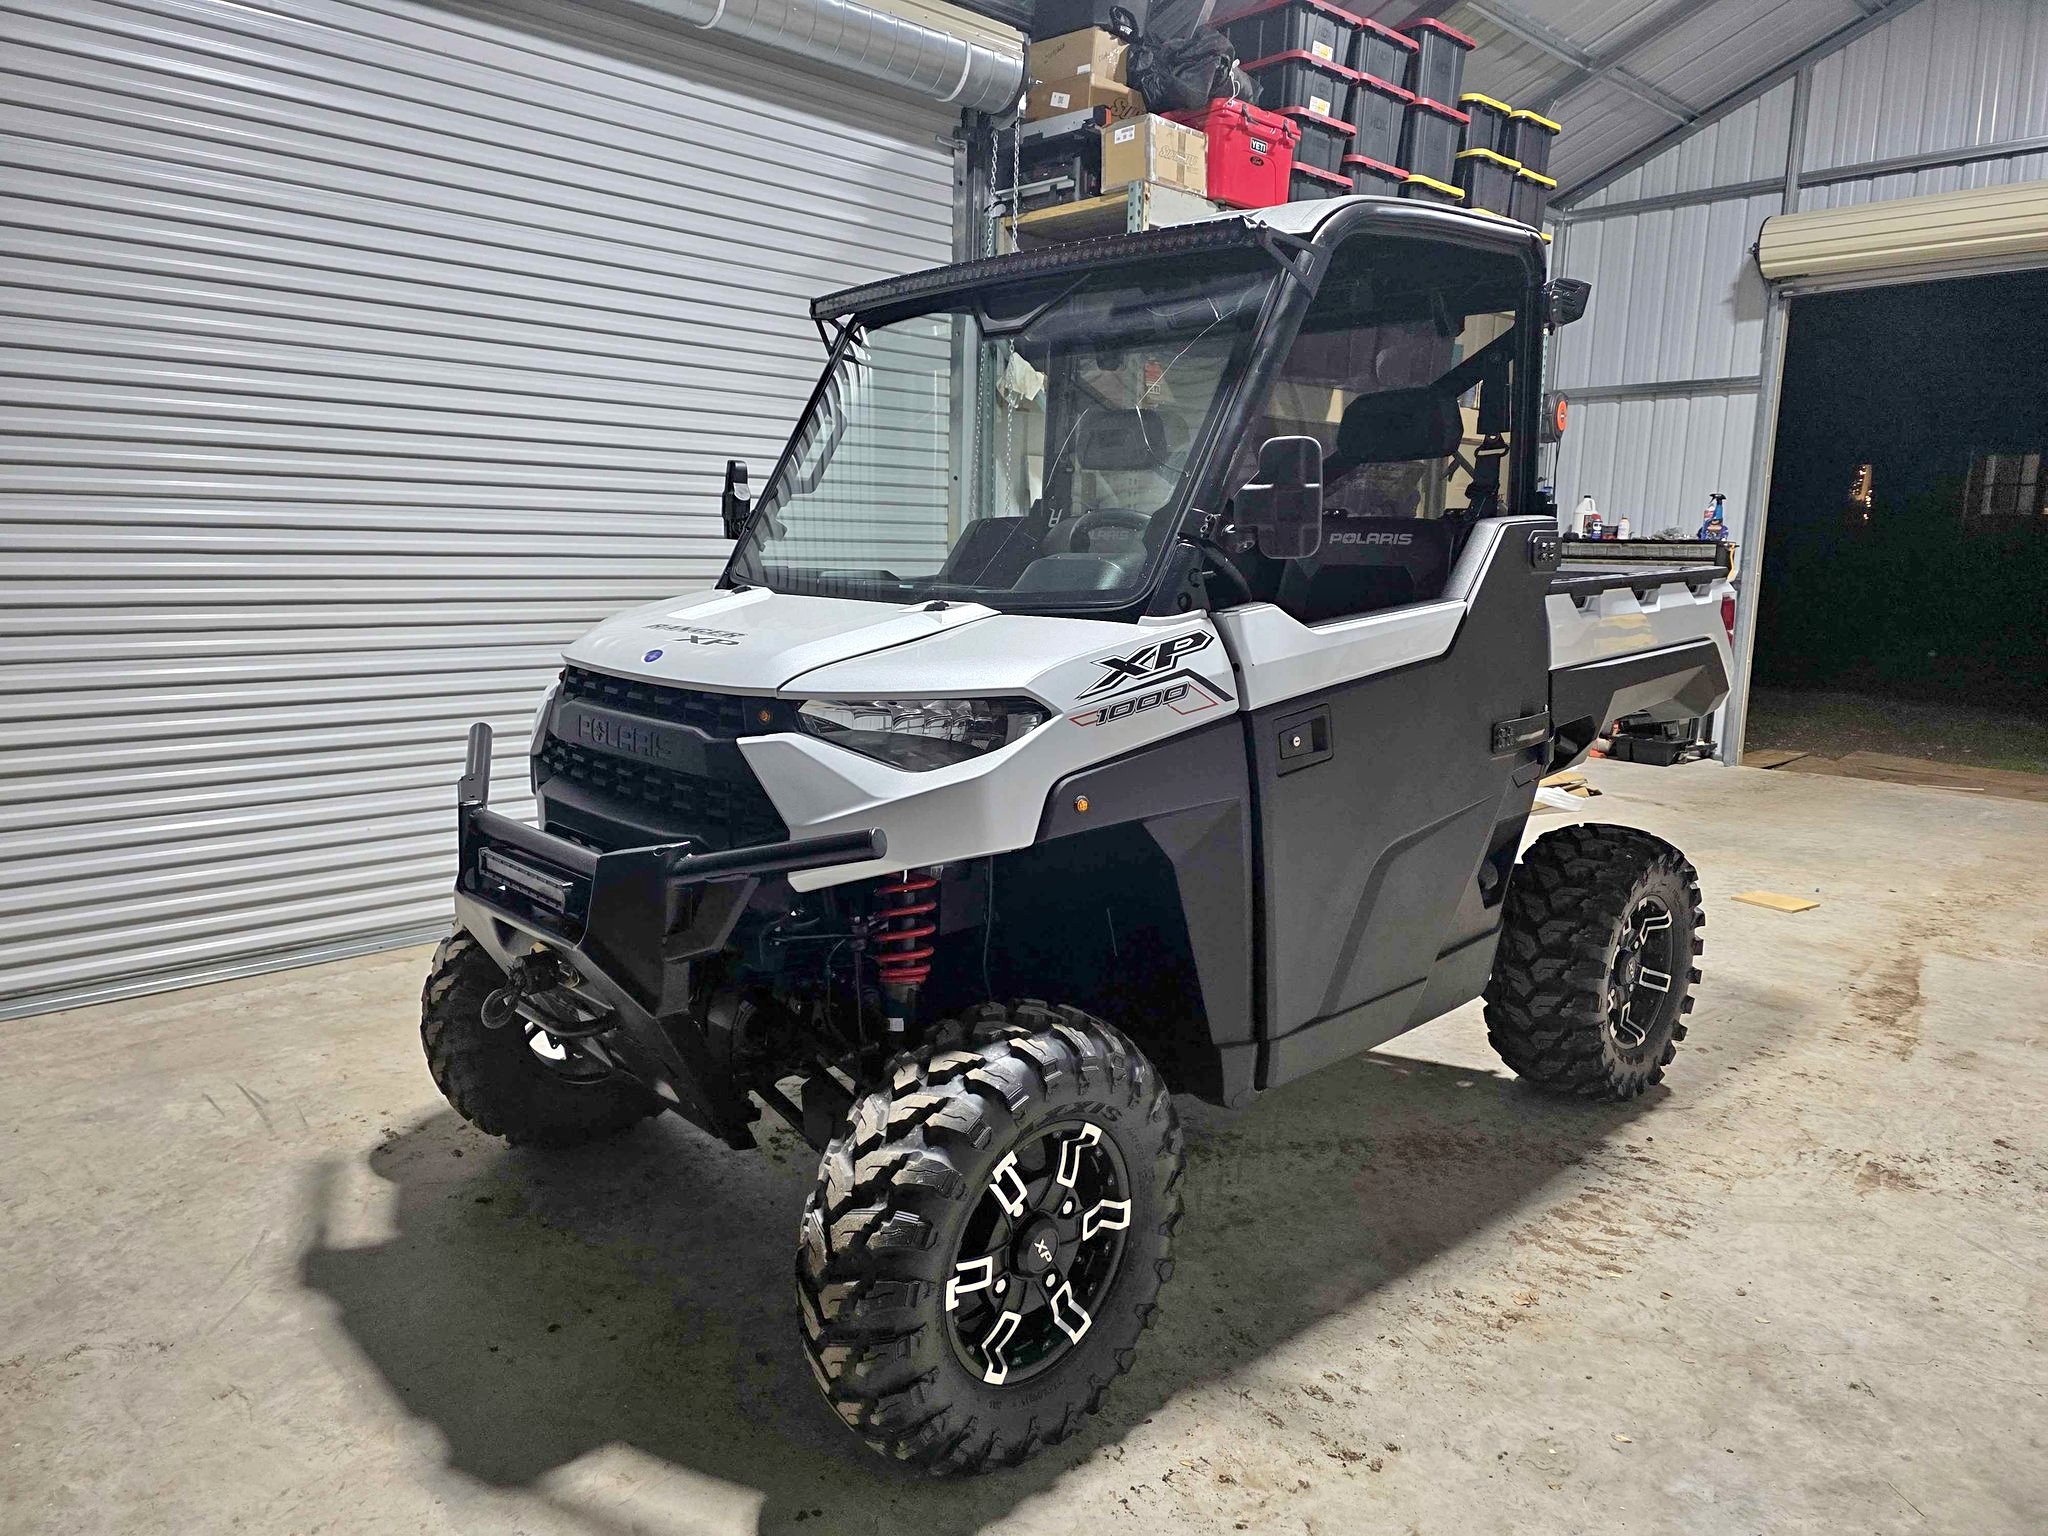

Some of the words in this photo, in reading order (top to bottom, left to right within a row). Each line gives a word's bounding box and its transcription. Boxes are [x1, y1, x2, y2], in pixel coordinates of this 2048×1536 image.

[1252, 140, 1266, 152] YETI
[1329, 533, 1413, 545] POLARIS
[641, 623, 747, 638] RANGER
[671, 635, 740, 646] XP
[1075, 629, 1215, 700] XP
[1096, 682, 1190, 726] 1000
[577, 713, 673, 758] POLARIS
[1034, 1239, 1053, 1262] XP
